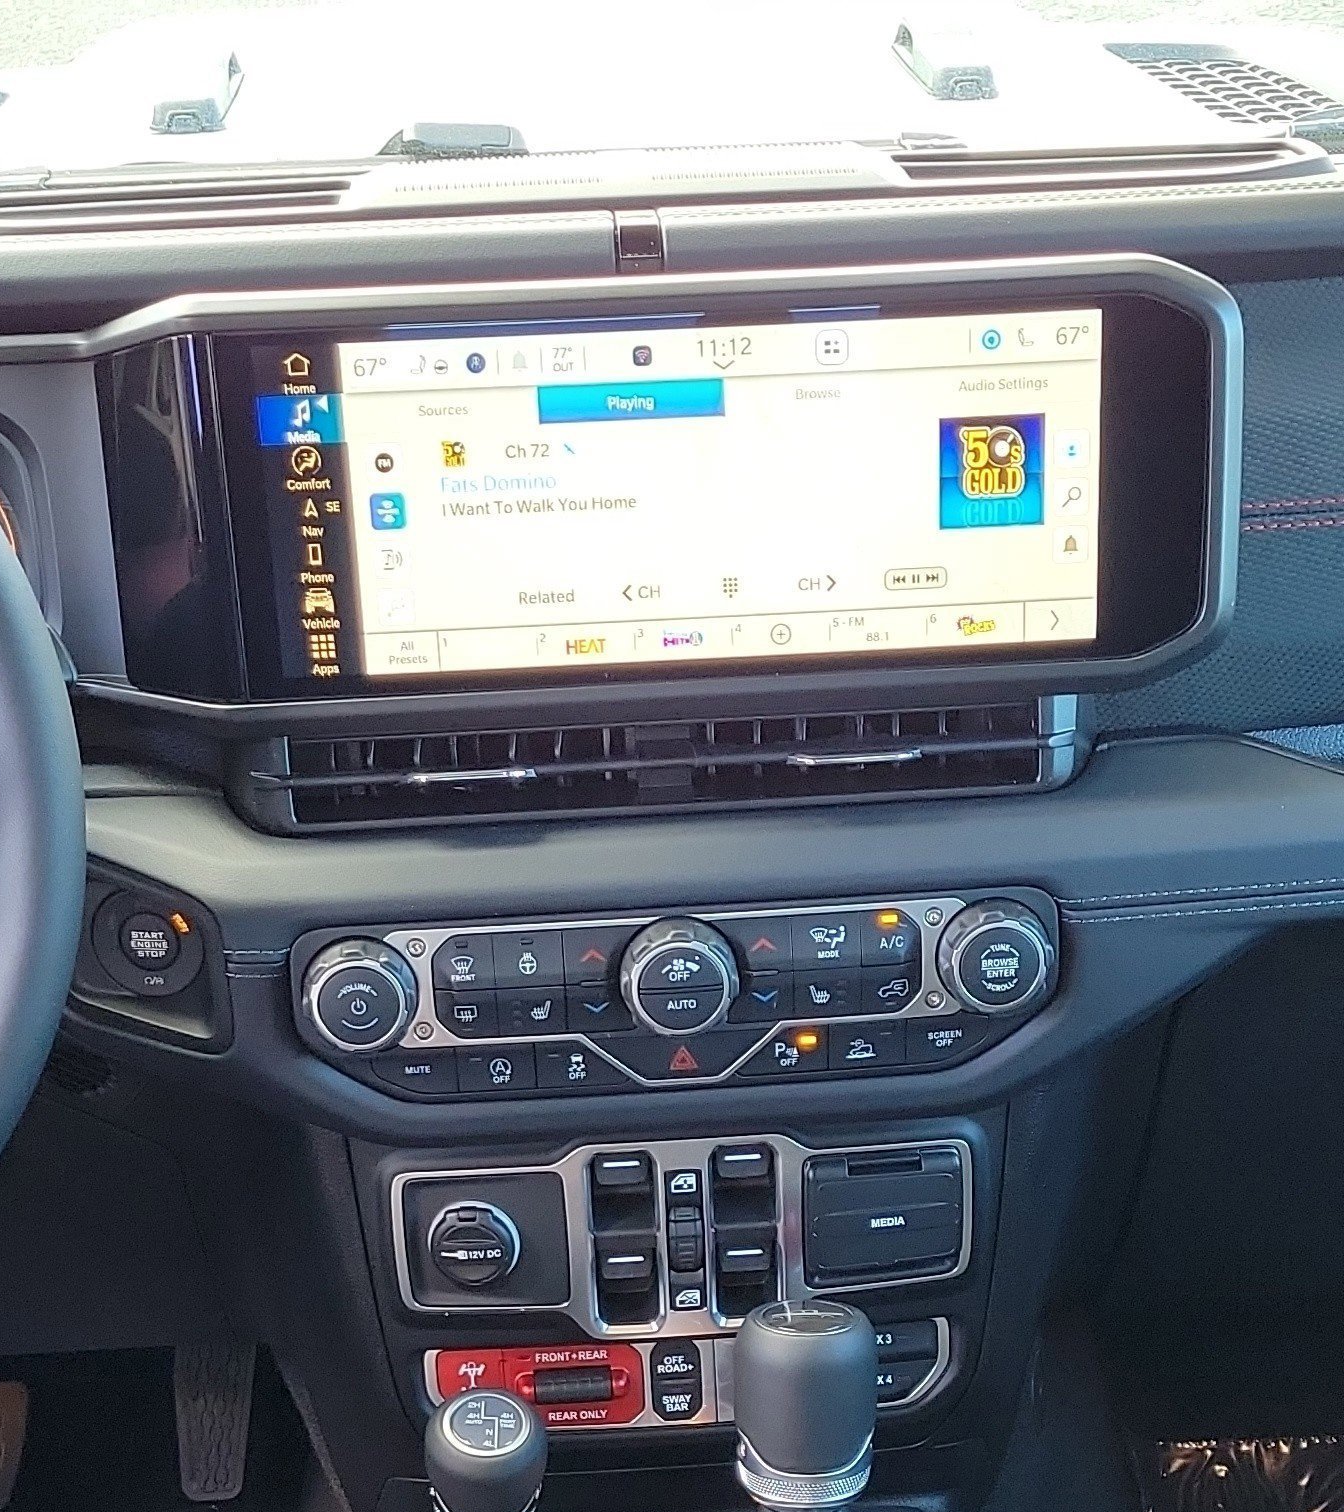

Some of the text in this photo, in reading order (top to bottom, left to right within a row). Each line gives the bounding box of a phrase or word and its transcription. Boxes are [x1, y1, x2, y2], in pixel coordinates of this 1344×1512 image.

[696, 337, 753, 358] 11:12
[552, 362, 574, 372] OUT
[283, 383, 317, 395] Home
[958, 376, 1049, 393] Audio Settings
[795, 387, 841, 400] Browse
[606, 395, 655, 412] Playing
[418, 404, 469, 417] Sources
[287, 430, 321, 444] Media
[505, 443, 550, 458] Ch 72
[287, 477, 331, 490] Comfort
[440, 473, 557, 493] Fats Domino
[967, 467, 1023, 495] GOLD
[325, 501, 341, 513] SE
[450, 501, 490, 516] Want
[494, 500, 513, 514] To
[516, 498, 554, 514] Walk
[558, 498, 588, 512] You
[592, 496, 637, 511] Home
[302, 526, 324, 538] Nav
[300, 571, 334, 584] Phone
[798, 577, 821, 591] CH
[518, 590, 575, 604] Related
[638, 586, 661, 599] CH
[302, 617, 341, 630] Vehicle
[849, 616, 865, 627] FM
[400, 641, 415, 651] All
[566, 638, 607, 656] HEAT
[388, 653, 429, 665] Presets
[312, 663, 341, 676] Apps
[131, 931, 165, 939] START
[131, 941, 169, 949] ENGINE
[879, 934, 905, 950] A/C
[137, 950, 166, 958] STOP
[817, 949, 840, 960] MODE
[981, 957, 1019, 968] BROWSE
[451, 974, 476, 982] FRONT
[668, 970, 690, 982] OFF
[986, 968, 1016, 979] ENTER
[342, 983, 372, 995] VOLUME
[986, 979, 1015, 992] SCROLL
[667, 999, 697, 1011] AUTO
[927, 1029, 962, 1042] SCREEN
[936, 1038, 954, 1048] OFF
[780, 1057, 798, 1067] OFF
[405, 1065, 431, 1074] MUTE
[492, 1075, 511, 1084] OFF
[569, 1072, 587, 1080] OFF
[871, 1216, 905, 1229] MEDIA
[468, 1248, 502, 1260] 12V DC
[664, 1355, 685, 1366] OFF
[662, 1393, 692, 1404] SWAY
[666, 1402, 689, 1412] BAR
[548, 1409, 607, 1421] REAR ONLY
